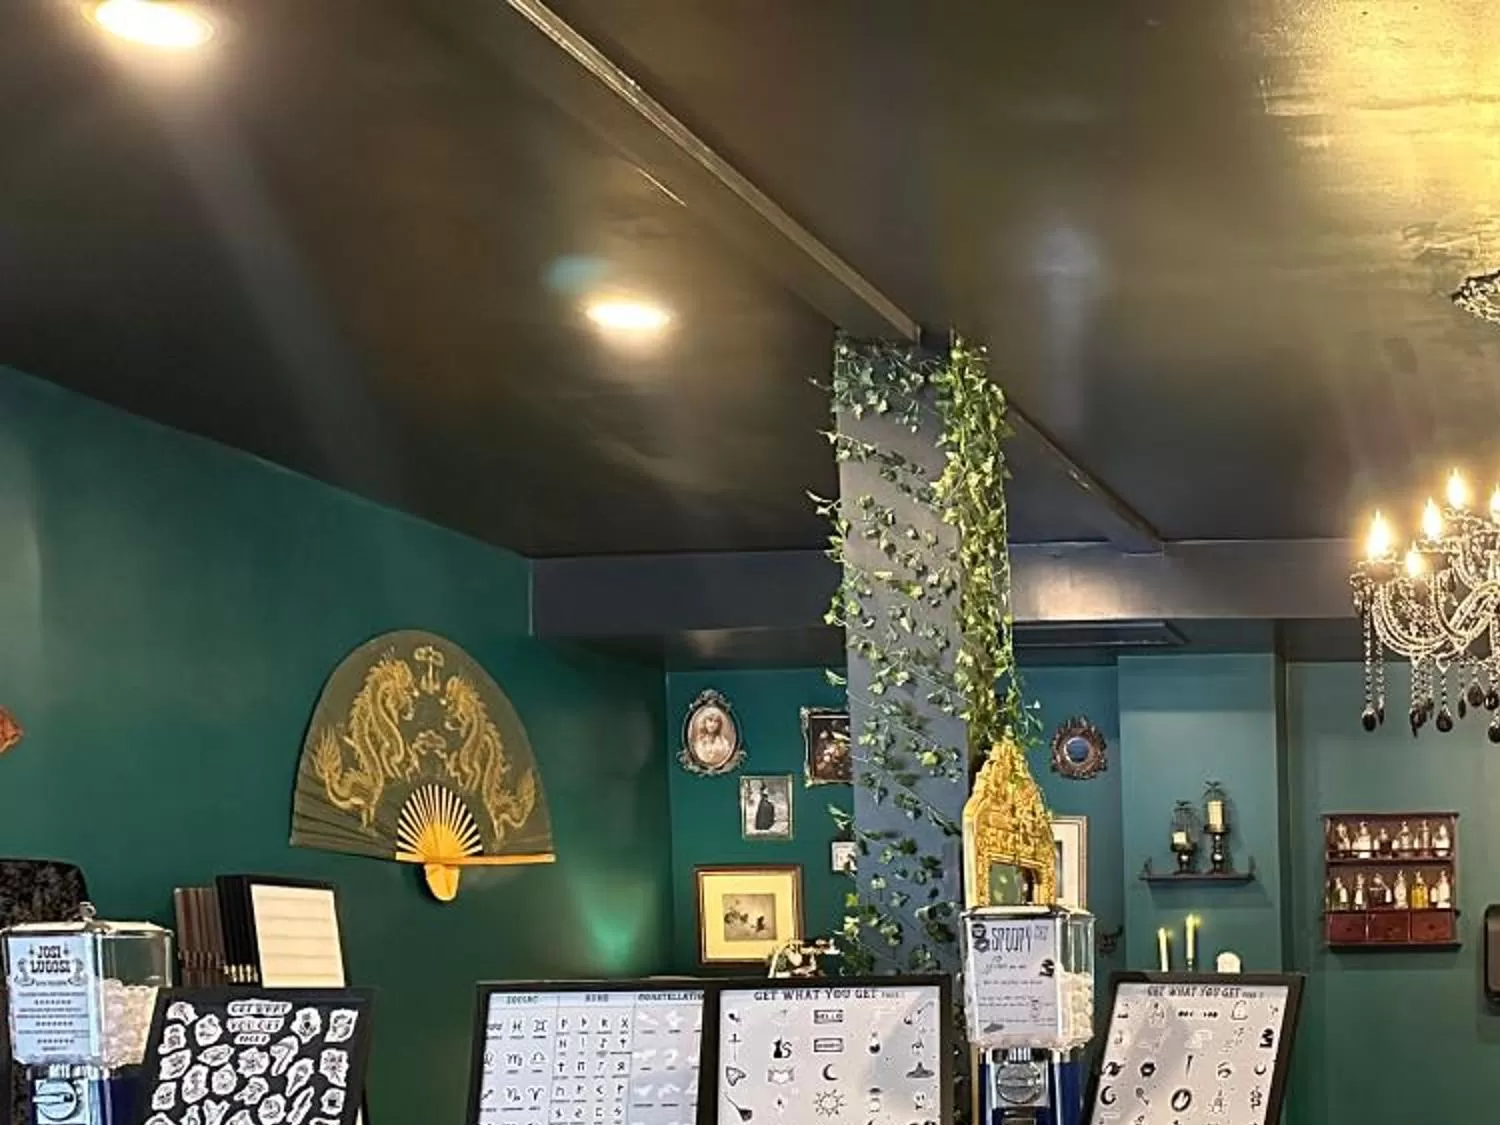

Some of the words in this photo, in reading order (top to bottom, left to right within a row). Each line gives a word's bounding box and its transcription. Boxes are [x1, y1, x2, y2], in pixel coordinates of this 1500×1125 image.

[753, 990, 777, 1001] GET
[783, 989, 820, 1001] WHAT
[825, 987, 851, 999] YOU
[855, 988, 877, 999] GET
[1200, 985, 1220, 997] YOU
[1221, 987, 1242, 999] GET
